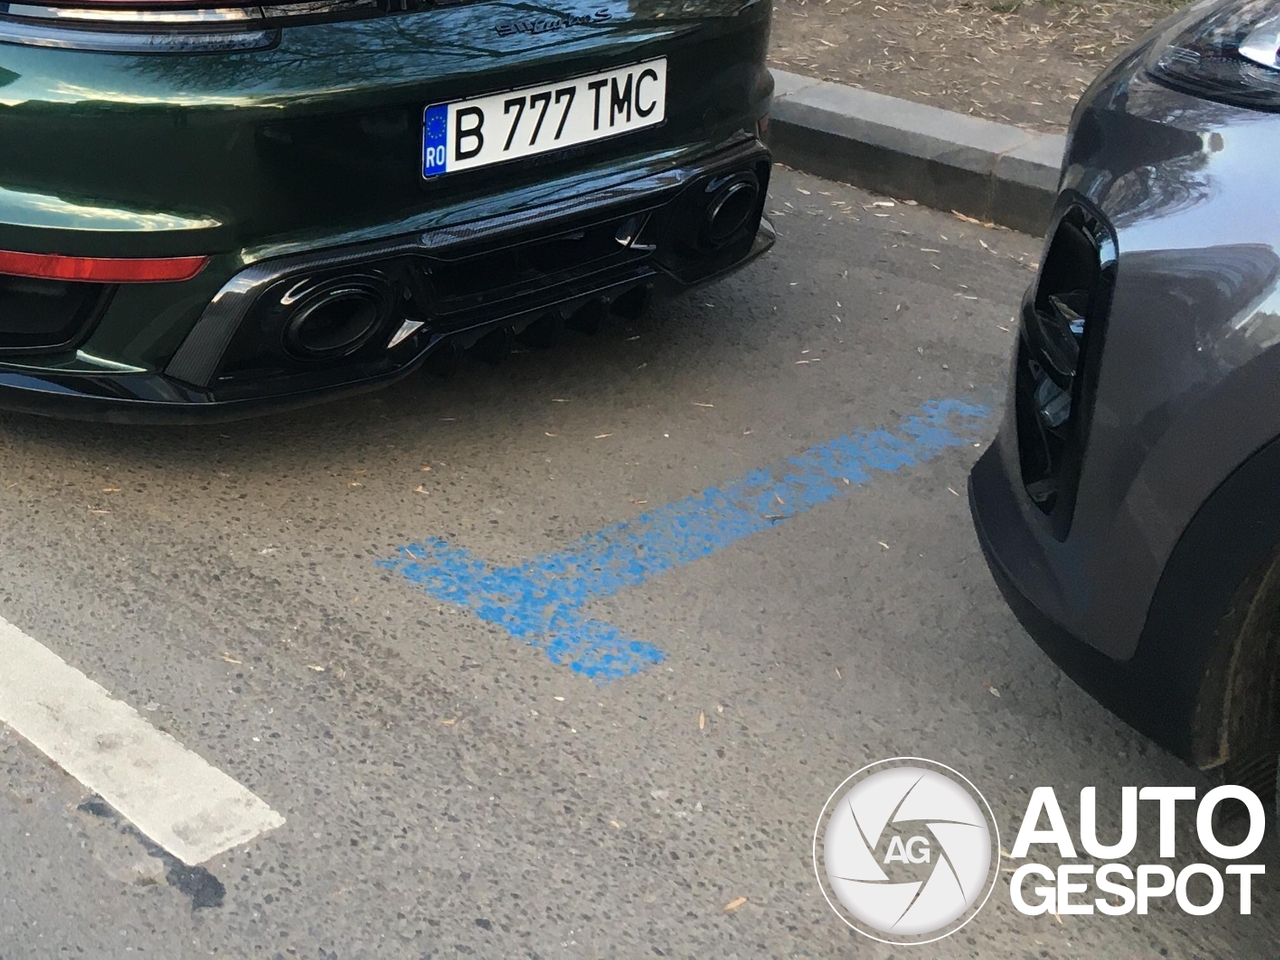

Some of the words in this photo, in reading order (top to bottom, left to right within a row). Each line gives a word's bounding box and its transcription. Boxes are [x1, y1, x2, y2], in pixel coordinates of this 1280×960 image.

[593, 8, 613, 23] S
[455, 106, 484, 161] B
[503, 86, 576, 151] 777
[588, 68, 658, 130] TMC
[426, 145, 445, 168] RO
